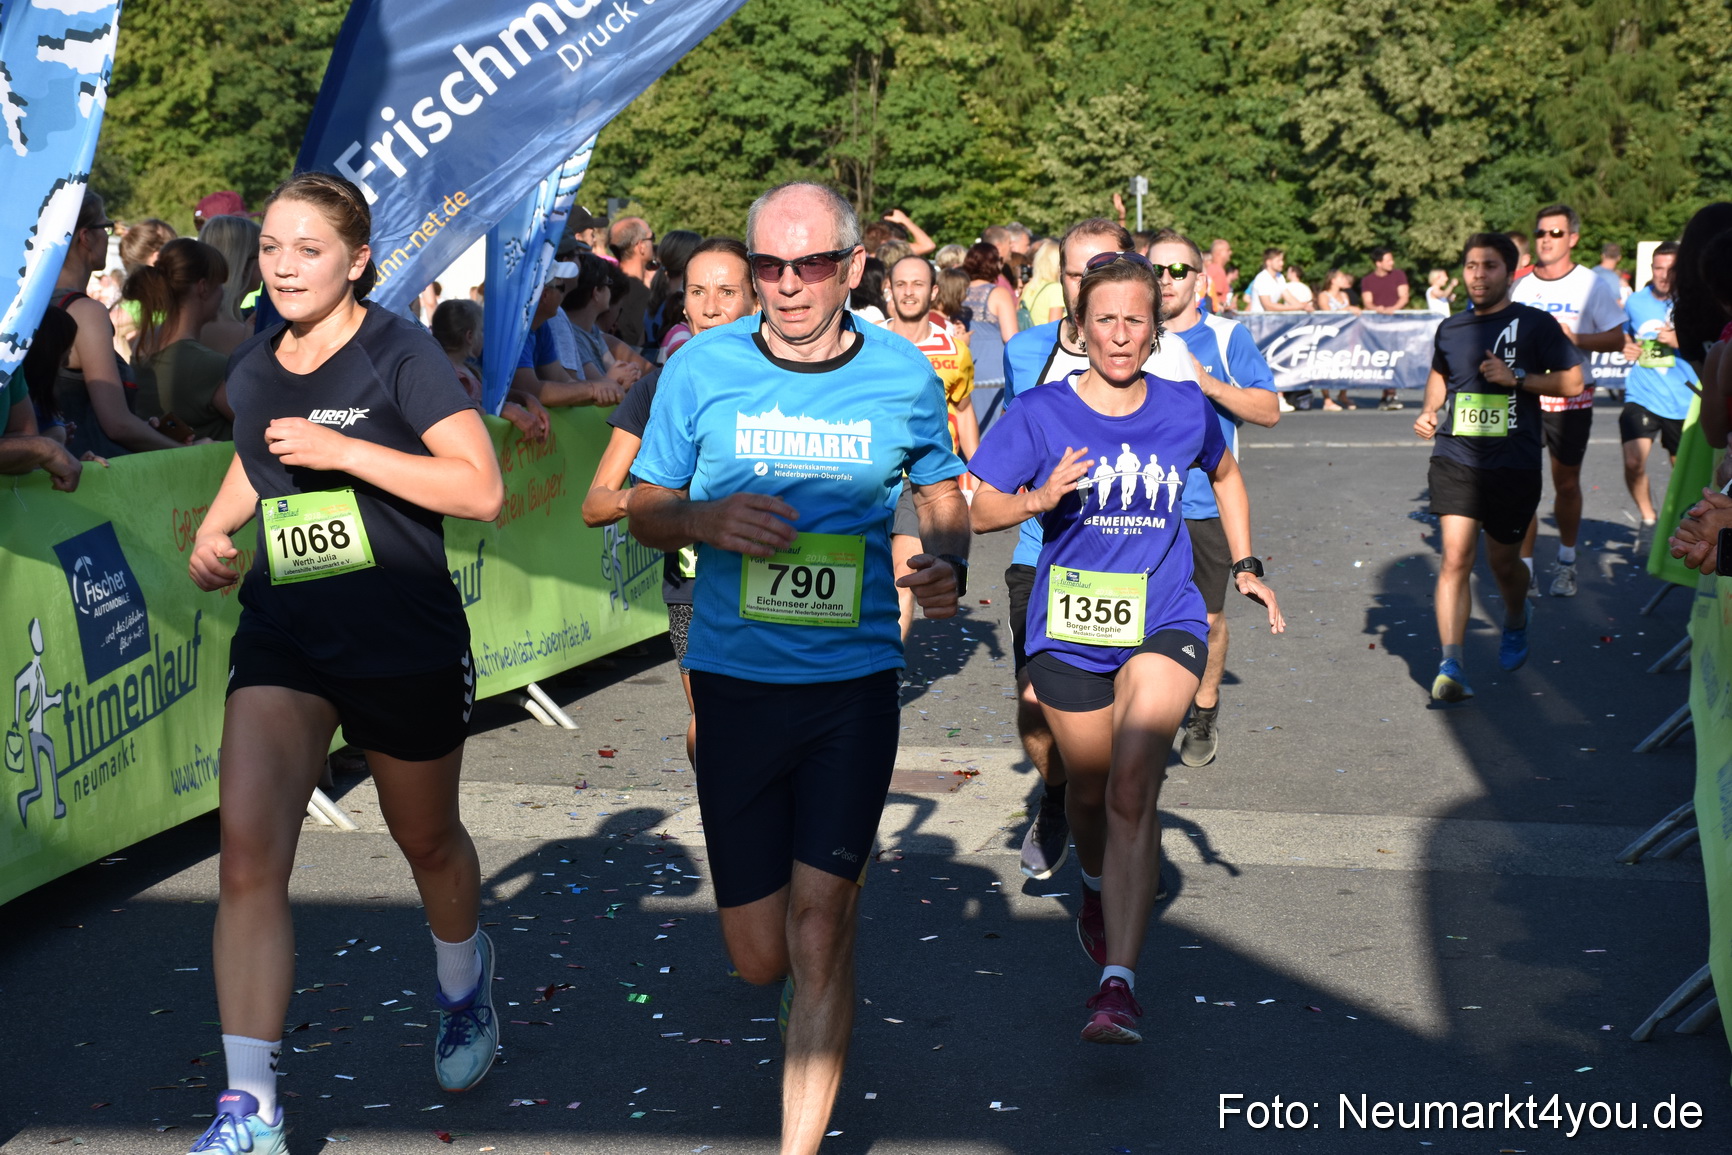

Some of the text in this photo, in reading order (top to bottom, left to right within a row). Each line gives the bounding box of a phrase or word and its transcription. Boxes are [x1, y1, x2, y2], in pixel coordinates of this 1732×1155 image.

[556, 1, 639, 72] Druck
[366, 191, 470, 298] ann-net.de
[1290, 344, 1405, 368] Fischer
[1301, 368, 1394, 380] AUTOMOBILE
[1461, 409, 1500, 424] 1605
[735, 430, 872, 459] NEUMARKT
[774, 462, 840, 472] Handwerkskammer
[774, 470, 853, 482] Niederbayern-Oberpfalz
[1084, 515, 1166, 529] GEMEINSAM
[277, 519, 351, 558] 1068
[284, 565, 312, 575] Lebenshilfe
[312, 562, 340, 571] Neumarkt
[292, 554, 337, 567] Werth Julia
[83, 569, 127, 606] Fischer
[768, 563, 836, 600] 790
[93, 592, 131, 619] AUTOMOBILE
[746, 604, 852, 618] Handwerkskammer Niederbayern-Oberpfalz
[756, 596, 844, 611] Eichenseer Johann
[1059, 594, 1132, 625] 1356
[1066, 621, 1122, 633] Borger Stephie
[473, 612, 592, 679] ww.firmenlauf-oberpfalz.de
[62, 609, 203, 765] firmenlauf
[73, 740, 136, 803] neumarkt
